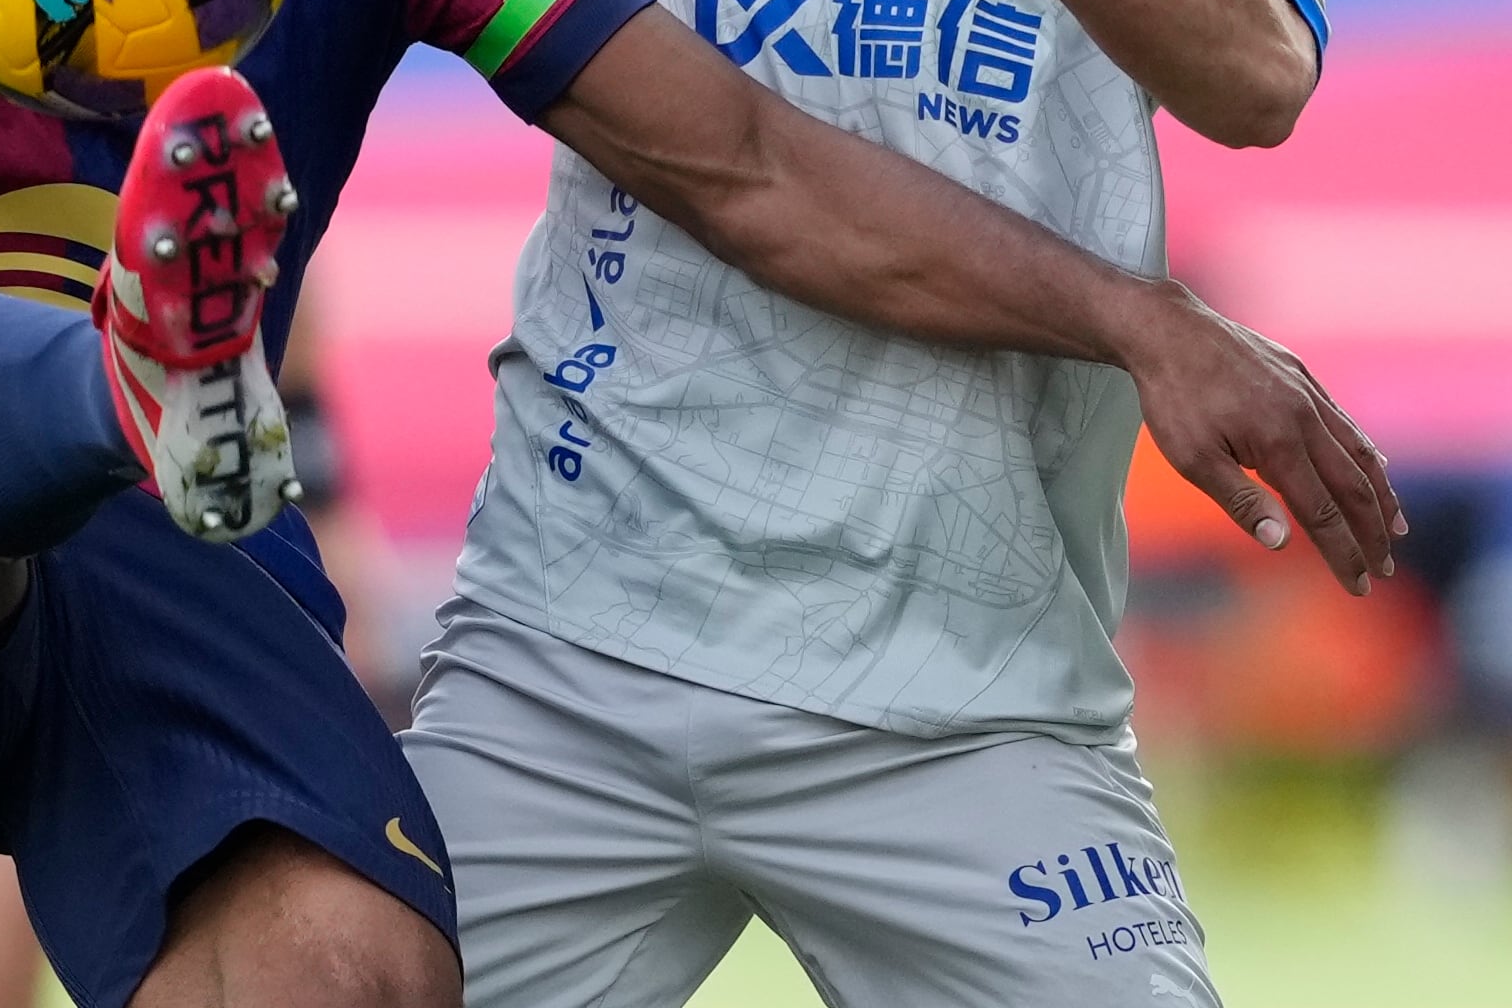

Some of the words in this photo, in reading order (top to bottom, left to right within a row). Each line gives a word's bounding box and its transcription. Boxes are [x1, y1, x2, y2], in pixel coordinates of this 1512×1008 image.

[918, 92, 1021, 144] NEWS
[1008, 842, 1183, 928] Silken
[1086, 919, 1187, 960] HOTELES
